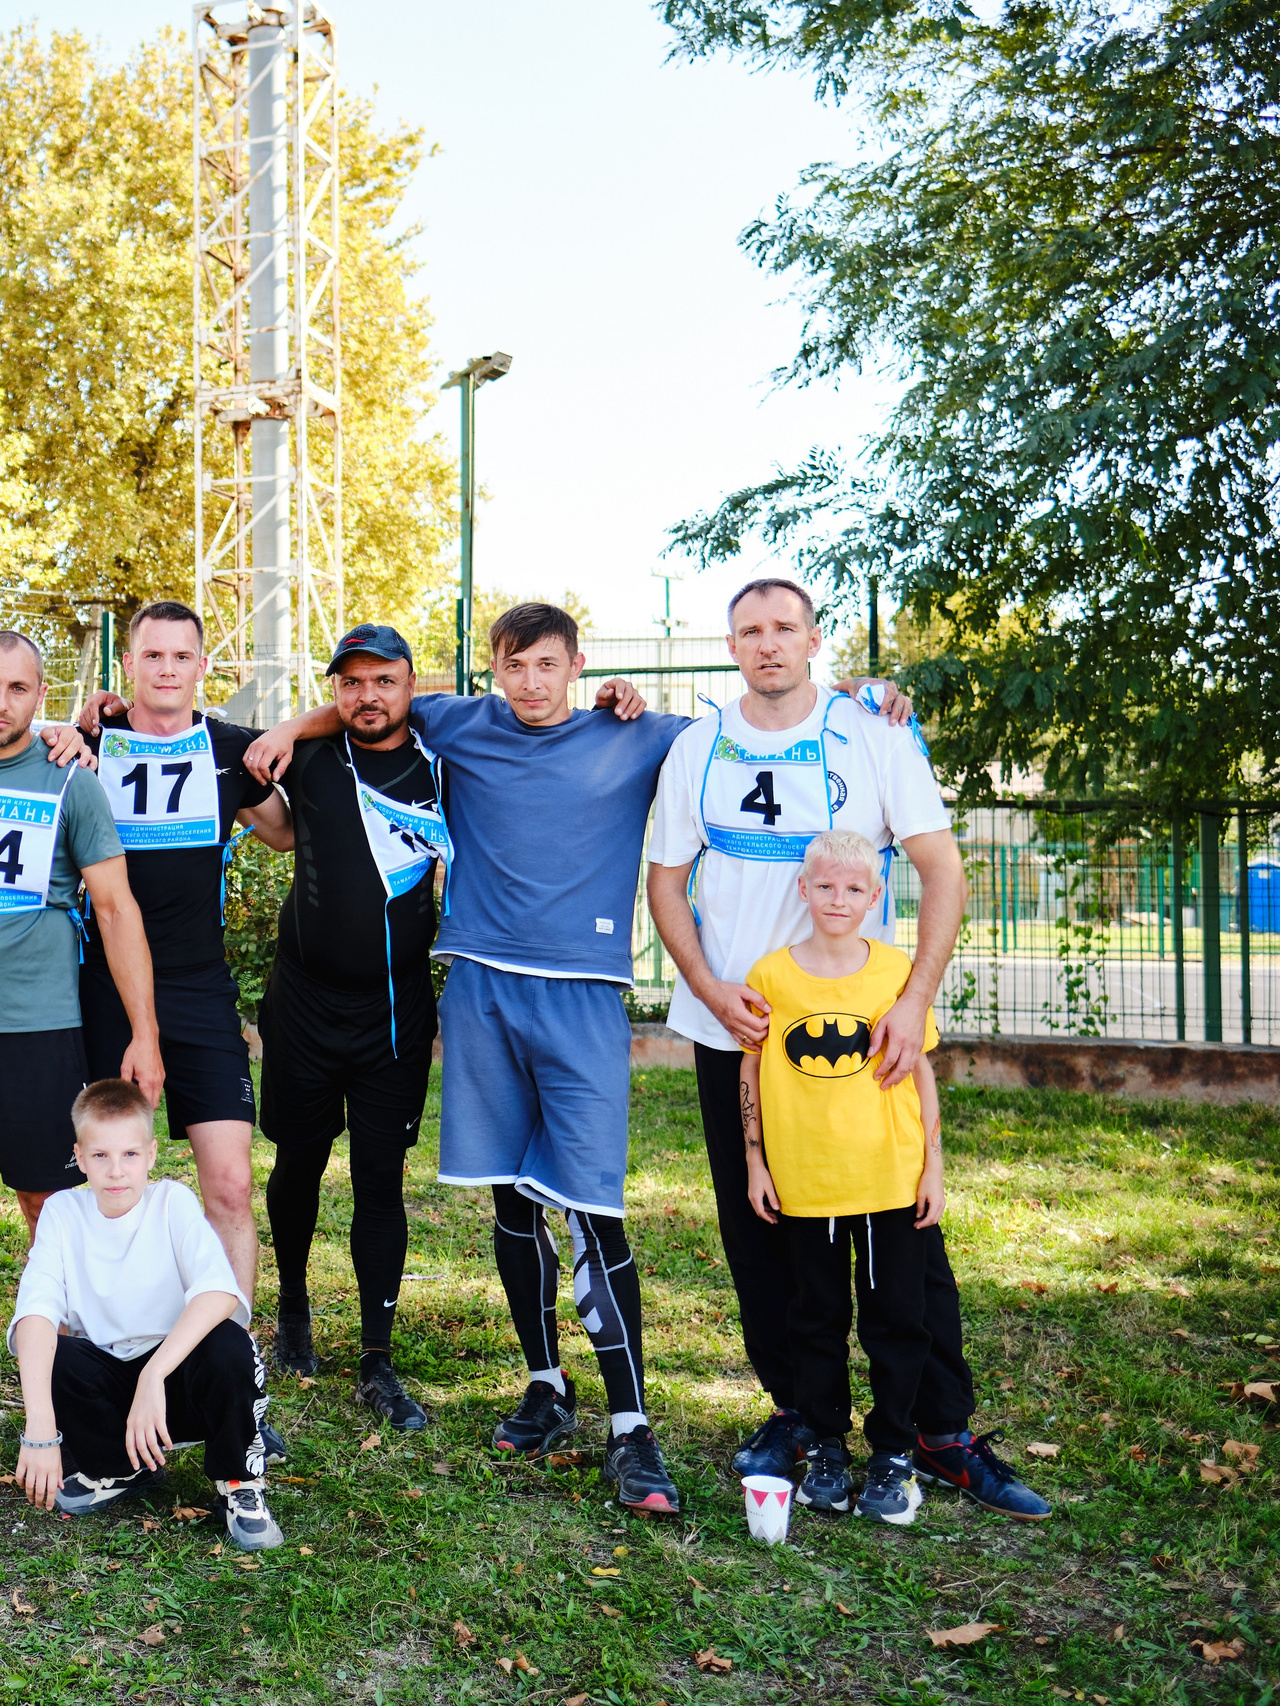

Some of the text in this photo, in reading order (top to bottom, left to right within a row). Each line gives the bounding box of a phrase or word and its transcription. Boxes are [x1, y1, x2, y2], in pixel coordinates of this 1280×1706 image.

[121, 761, 193, 816] 17
[739, 771, 782, 826] 4
[378, 806, 418, 824] СПОРТИВНЫЙ
[131, 824, 184, 832] АДМИНИСТРАЦИЯ
[176, 828, 212, 836] ПОСЕЛЕНИЯ
[731, 833, 790, 844] АДМИНИСТРАЦИЯ
[743, 841, 781, 849] СЕЛЬСКОГО
